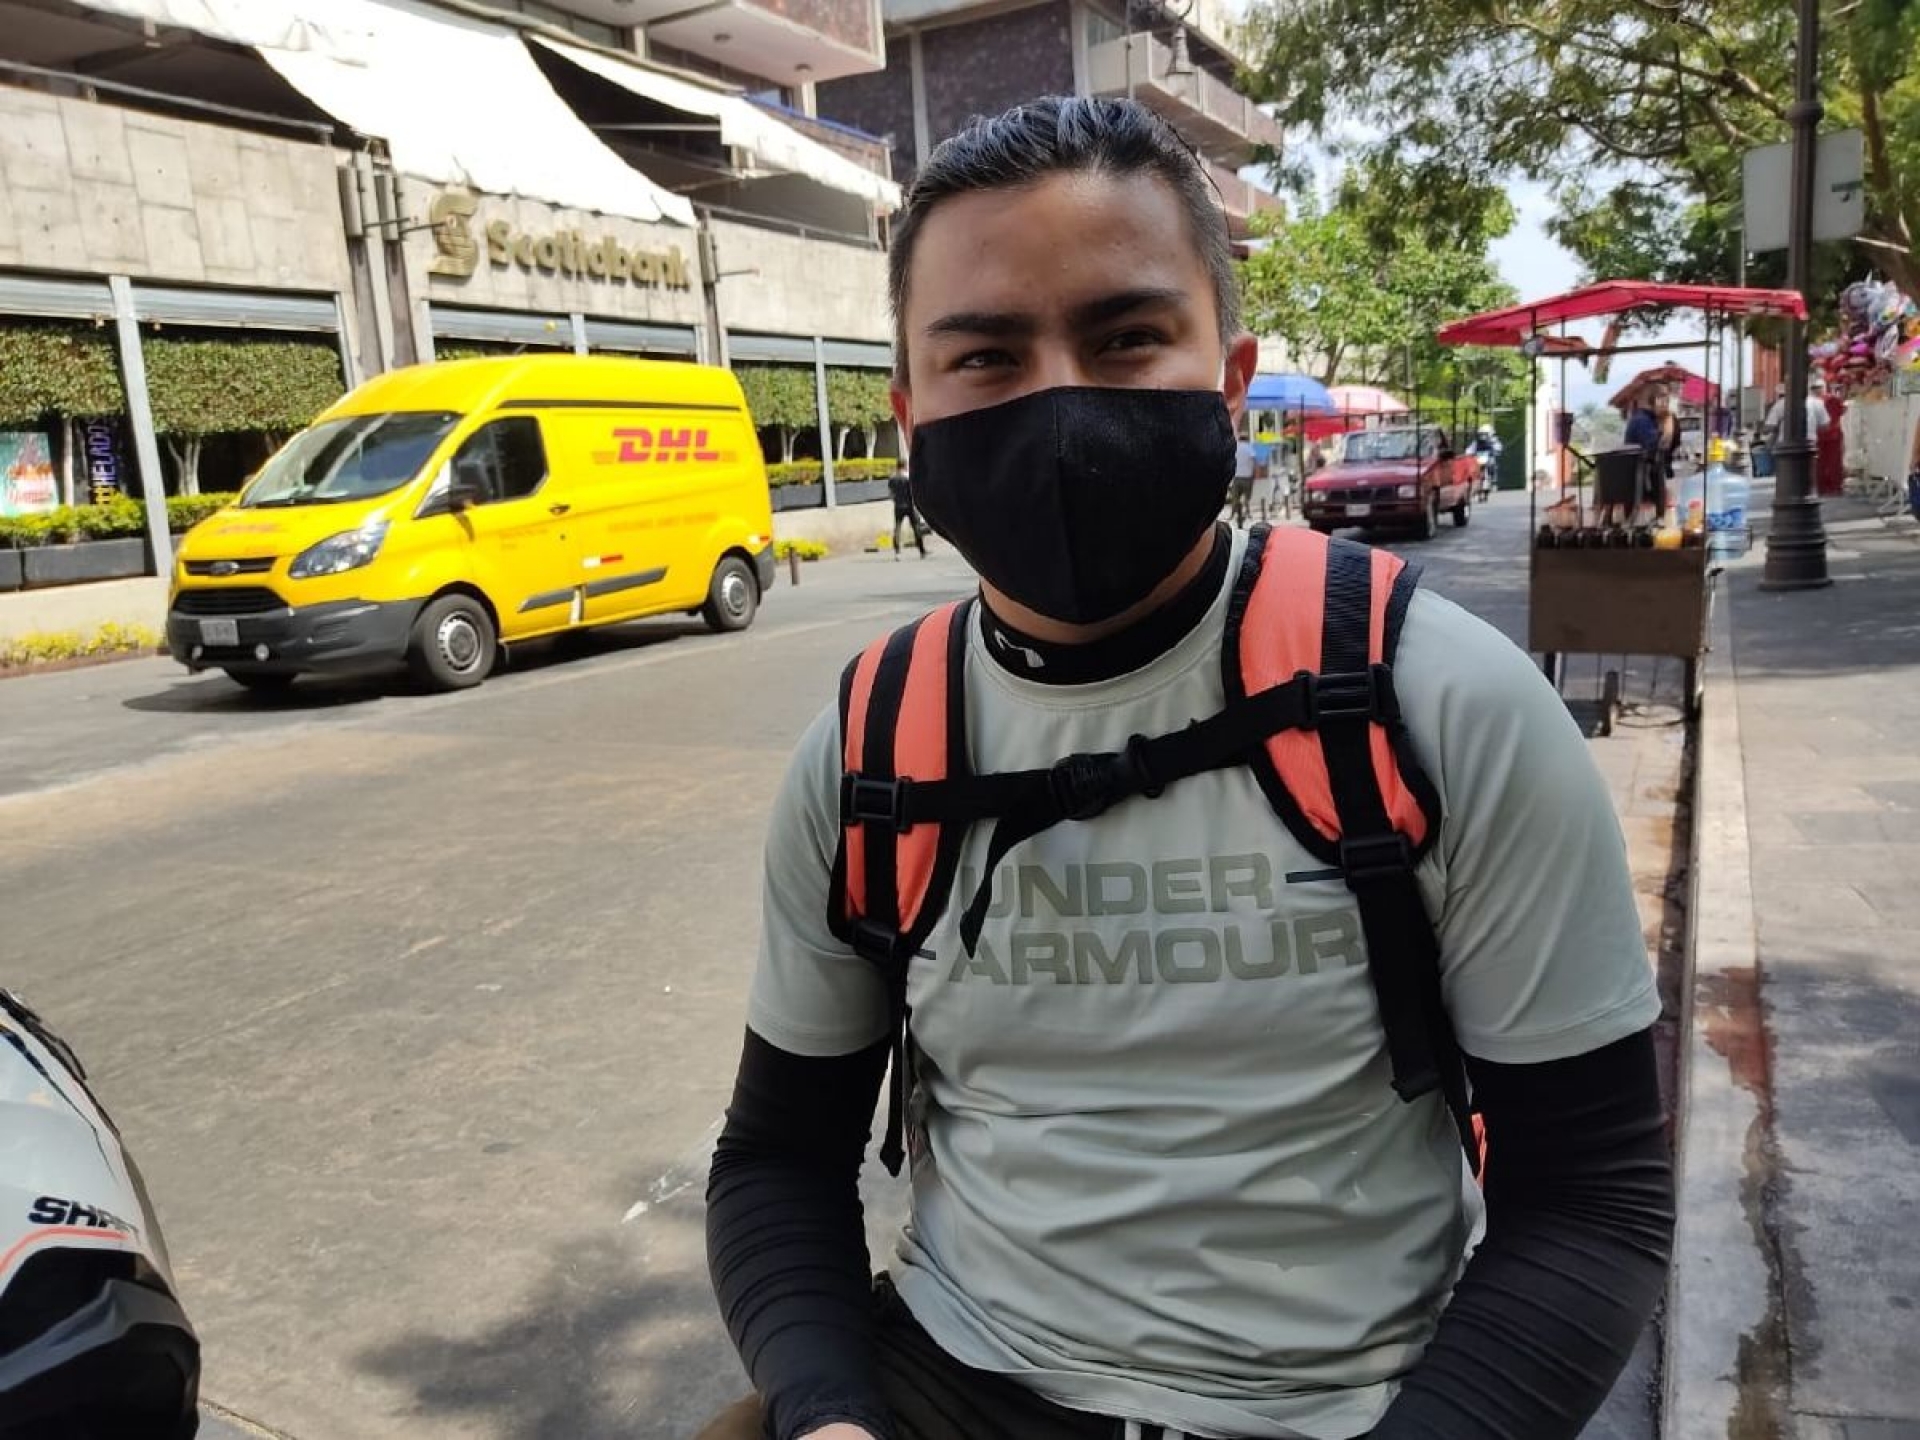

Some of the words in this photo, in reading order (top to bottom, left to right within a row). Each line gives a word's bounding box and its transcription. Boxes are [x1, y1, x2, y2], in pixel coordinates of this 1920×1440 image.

[486, 217, 690, 291] Scotiabank
[613, 428, 719, 462] DHL
[961, 852, 1275, 919] UNDER
[948, 908, 1367, 985] ARMOUR
